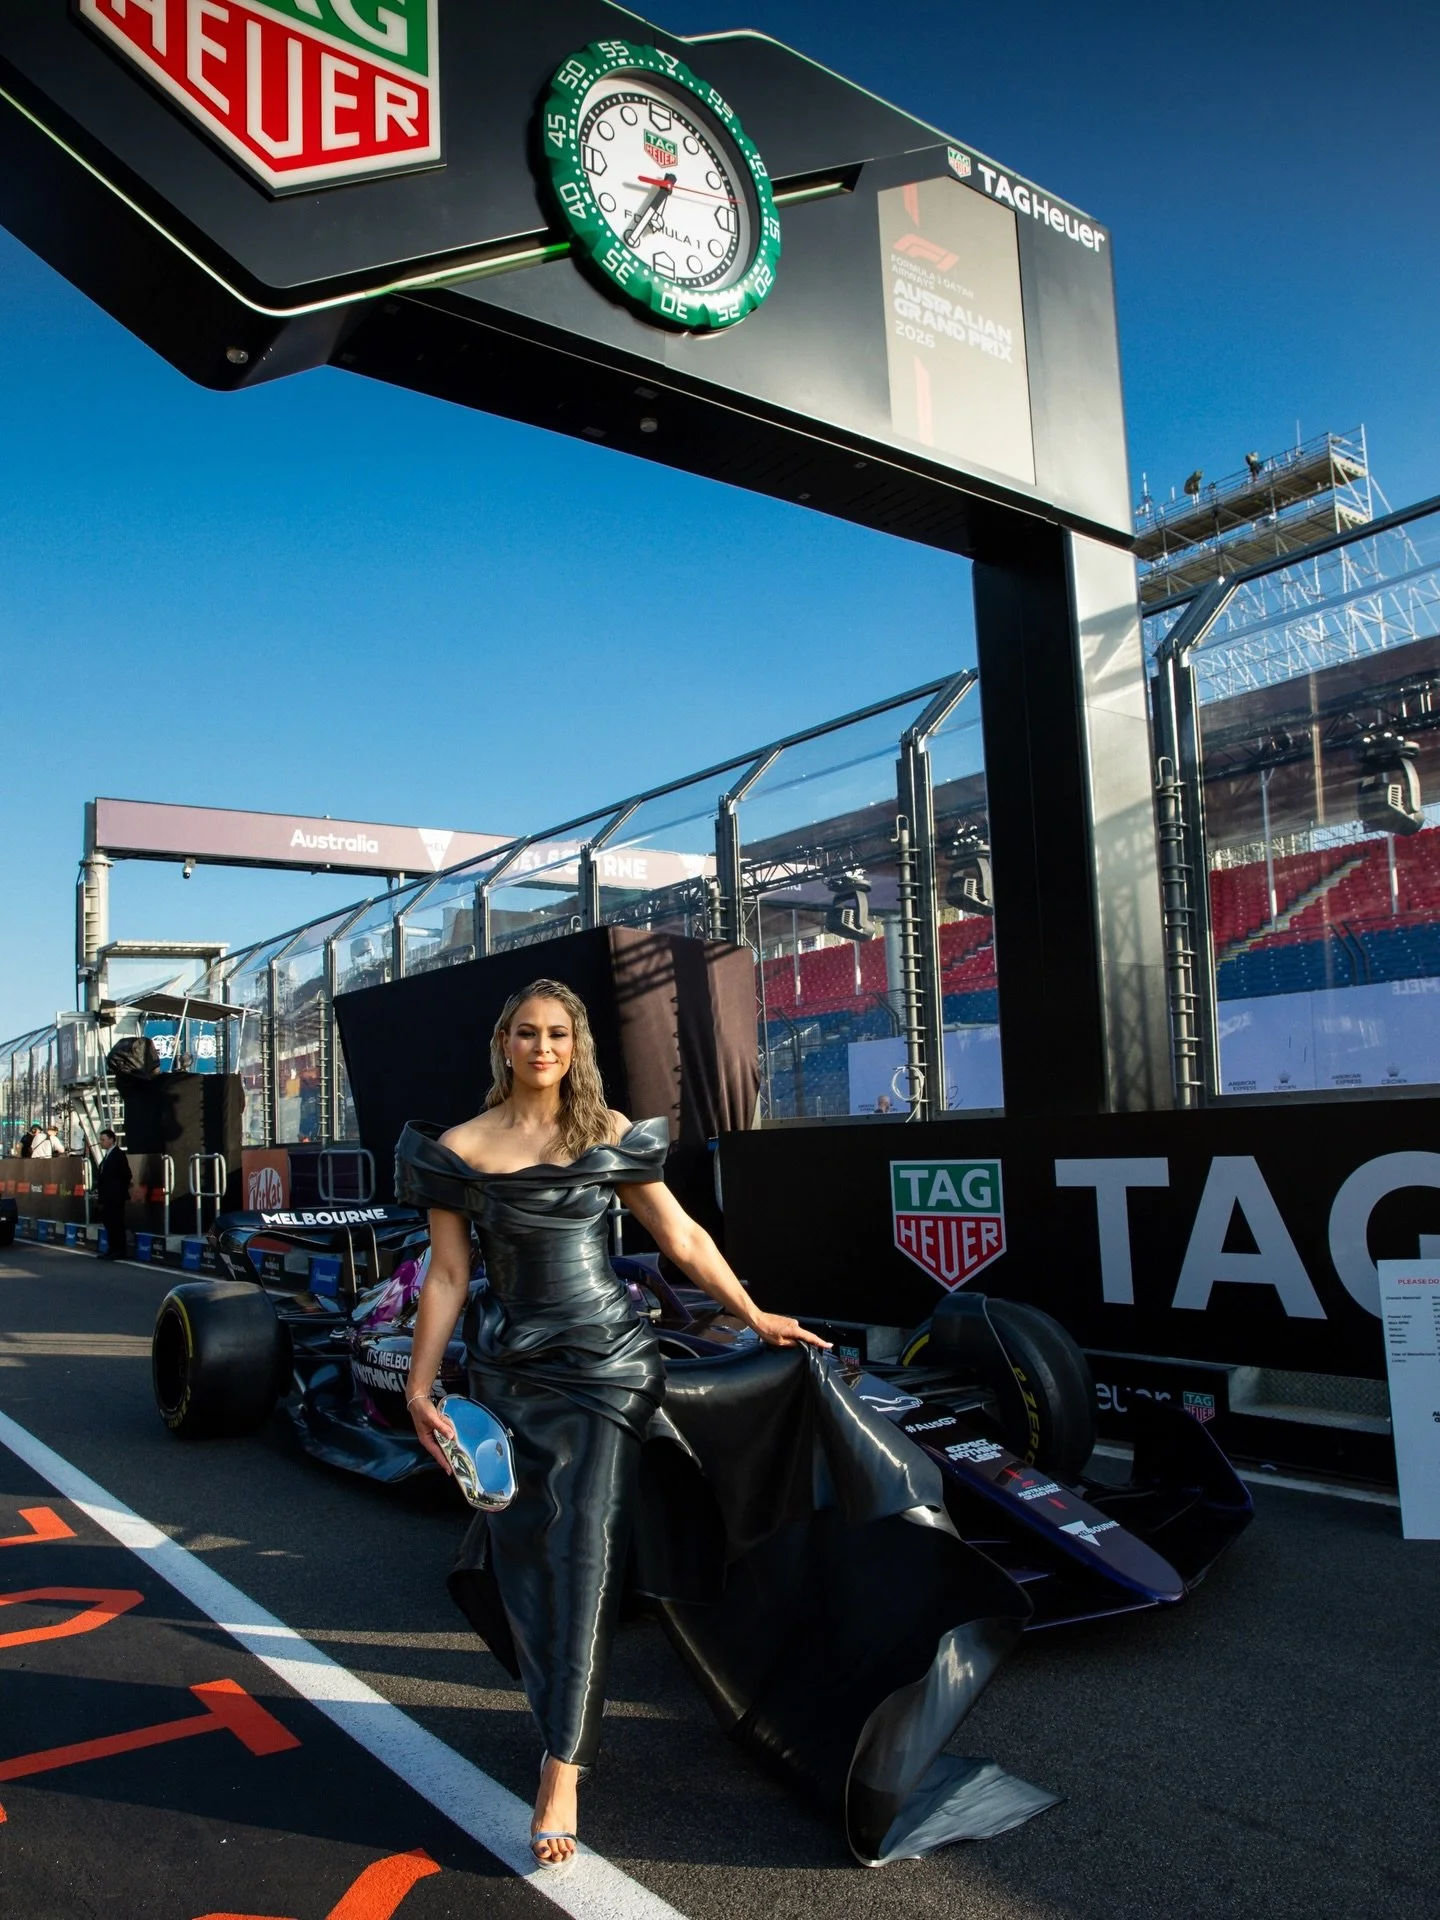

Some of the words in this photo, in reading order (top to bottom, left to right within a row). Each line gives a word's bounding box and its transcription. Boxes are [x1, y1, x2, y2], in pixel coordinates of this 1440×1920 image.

[598, 41, 629, 58] 55
[558, 60, 586, 89] 50
[548, 114, 567, 148] 45
[647, 134, 674, 154] TAG
[646, 146, 675, 165] HEUER
[752, 153, 767, 177] 10
[560, 182, 587, 220] 40
[602, 248, 635, 285] 35
[891, 254, 935, 281] FORMULA
[754, 270, 773, 298] 20
[661, 293, 688, 320] 30
[718, 305, 740, 322] 25
[894, 279, 1012, 345] AUSTRALIAN
[894, 298, 965, 341] GRAND
[969, 328, 1012, 363] PRIX
[895, 320, 935, 348] 2026
[290, 829, 378, 854] Australia
[899, 1168, 993, 1209] TAG
[261, 1208, 388, 1226] MELBOURNE
[899, 1217, 1000, 1277] HEUER
[1186, 1394, 1212, 1406] TAG
[945, 1438, 989, 1454] EXPECT
[948, 1443, 1004, 1461] NOTHING
[968, 1451, 1001, 1462] LESS
